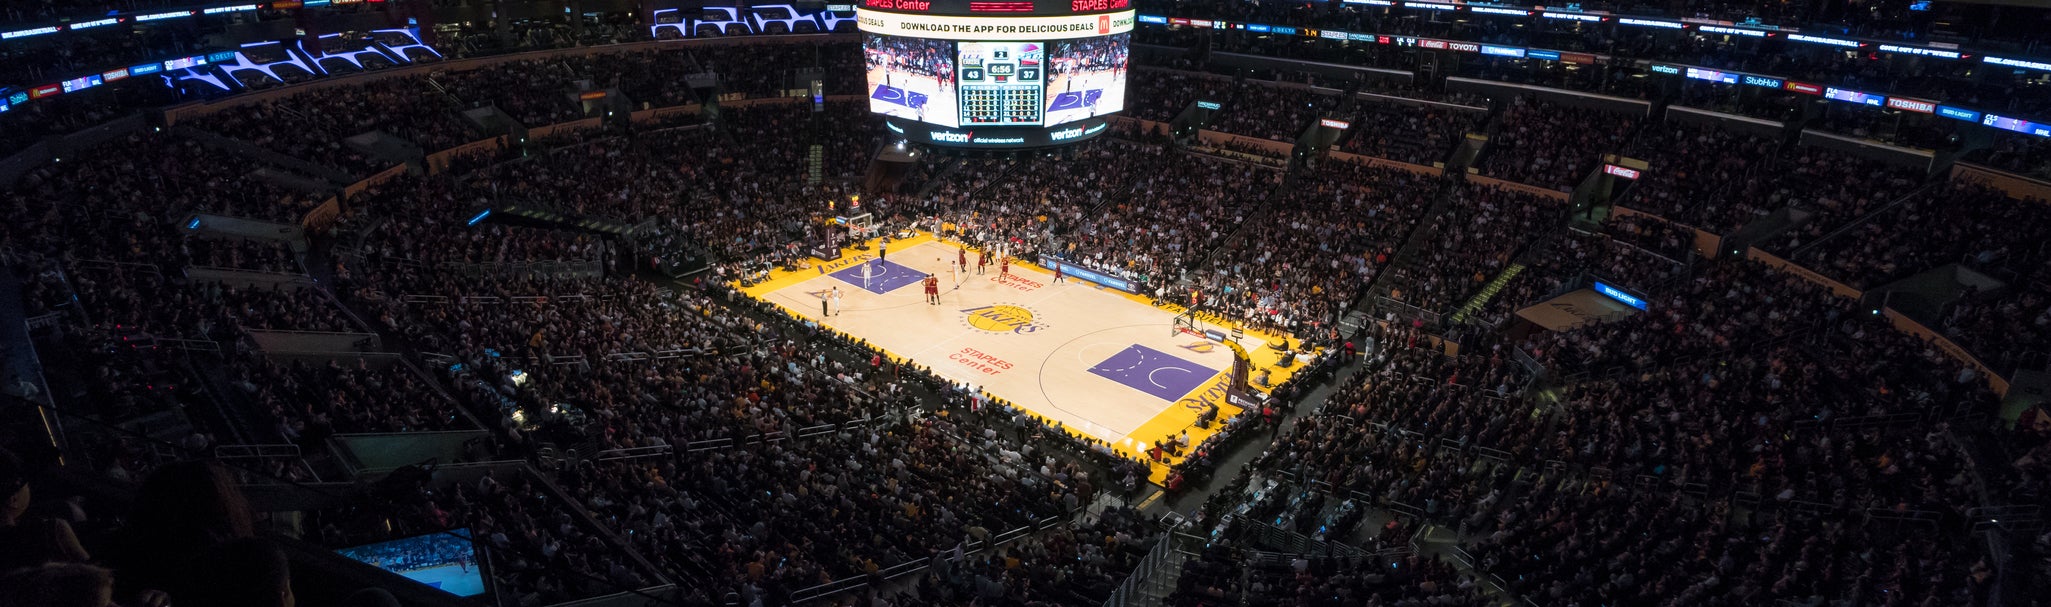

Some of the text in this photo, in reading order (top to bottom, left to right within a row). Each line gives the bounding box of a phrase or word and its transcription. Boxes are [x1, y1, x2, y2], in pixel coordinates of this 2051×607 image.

[896, 0, 930, 10] Center
[1072, 0, 1108, 11] STAPLES
[900, 21, 1094, 33] DOWNLOAD THE APP FOR DELICIOUS DEALS
[1449, 43, 1478, 51] TOYOTA
[215, 52, 235, 60] DELTA
[104, 69, 129, 80] TOSHIBA
[992, 65, 1010, 73] 6:56
[1652, 65, 1678, 74] verizon
[1745, 76, 1779, 88] StubHub
[1889, 98, 1934, 112] TOSHIBA
[1955, 110, 1973, 118] LIGHT
[930, 130, 968, 143] verizon
[1051, 127, 1082, 141] verizon
[2034, 128, 2050, 137] NHL
[817, 254, 872, 275] LAKERS
[1605, 287, 1636, 305] BUD LIGHT
[959, 305, 1050, 334] LAKERS
[949, 353, 1001, 376] Center
[960, 347, 1014, 370] STAPLES
